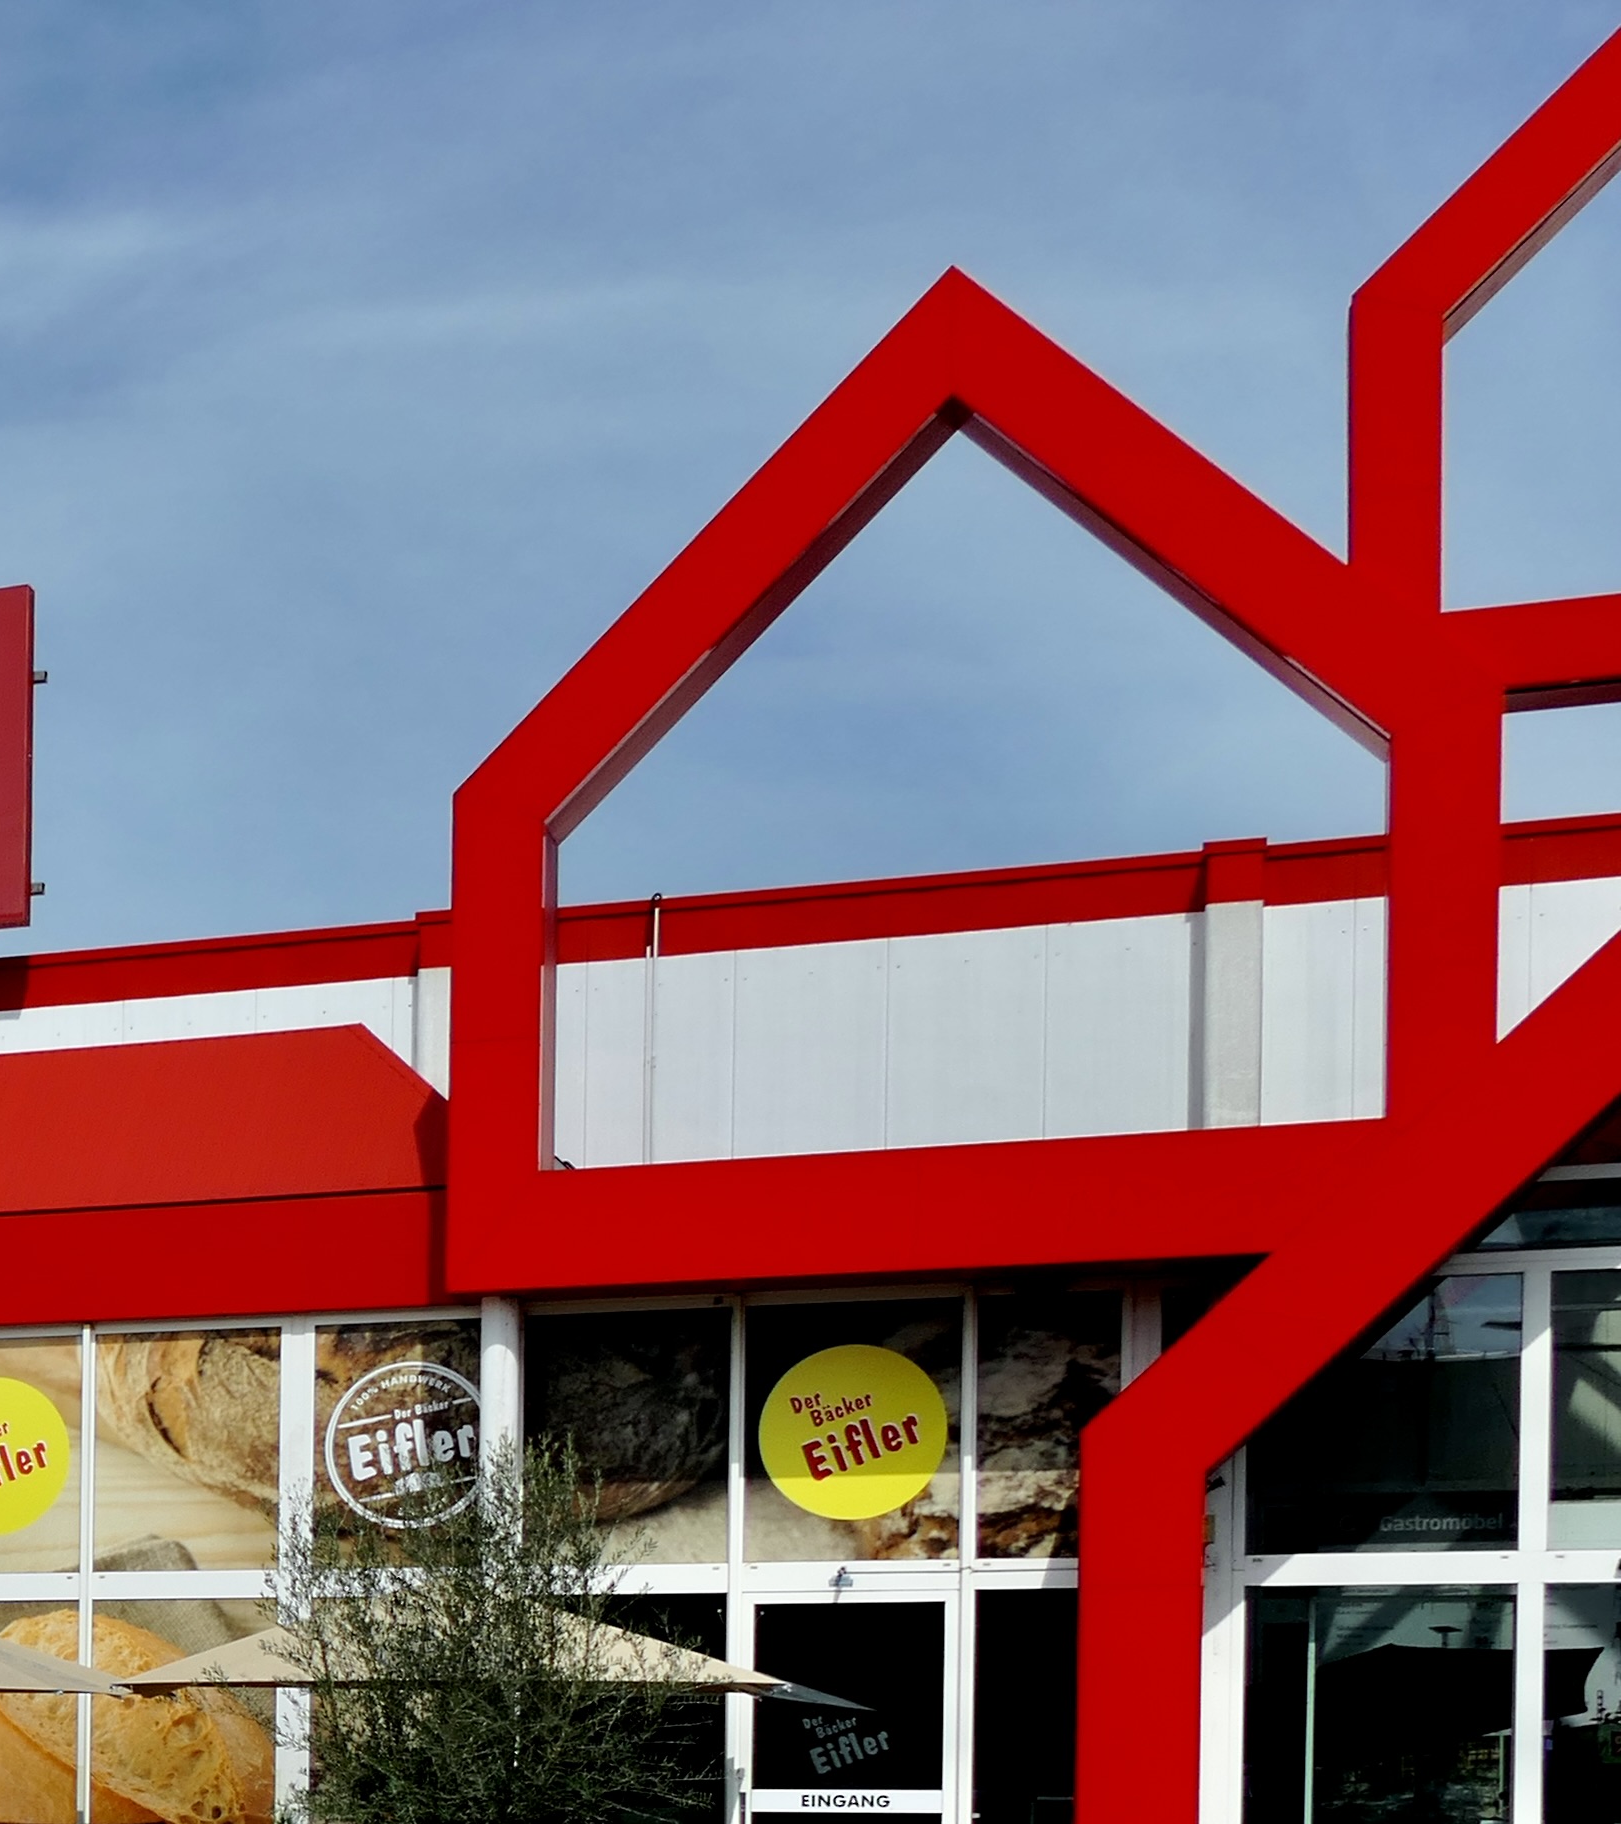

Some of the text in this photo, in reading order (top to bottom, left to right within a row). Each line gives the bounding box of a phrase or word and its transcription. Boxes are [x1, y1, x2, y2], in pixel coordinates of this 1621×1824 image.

[350, 1374, 452, 1411] 100% HANDWERK
[789, 1392, 821, 1414] Der
[393, 1408, 412, 1421] Der
[810, 1393, 873, 1427] Bäcker
[347, 1419, 476, 1482] Eifler
[801, 1414, 920, 1481] Eifler
[1379, 1511, 1504, 1532] Gastromöbel
[802, 1715, 823, 1729] Der
[809, 1730, 890, 1774] Eifler
[802, 1794, 890, 1807] EINGANG
